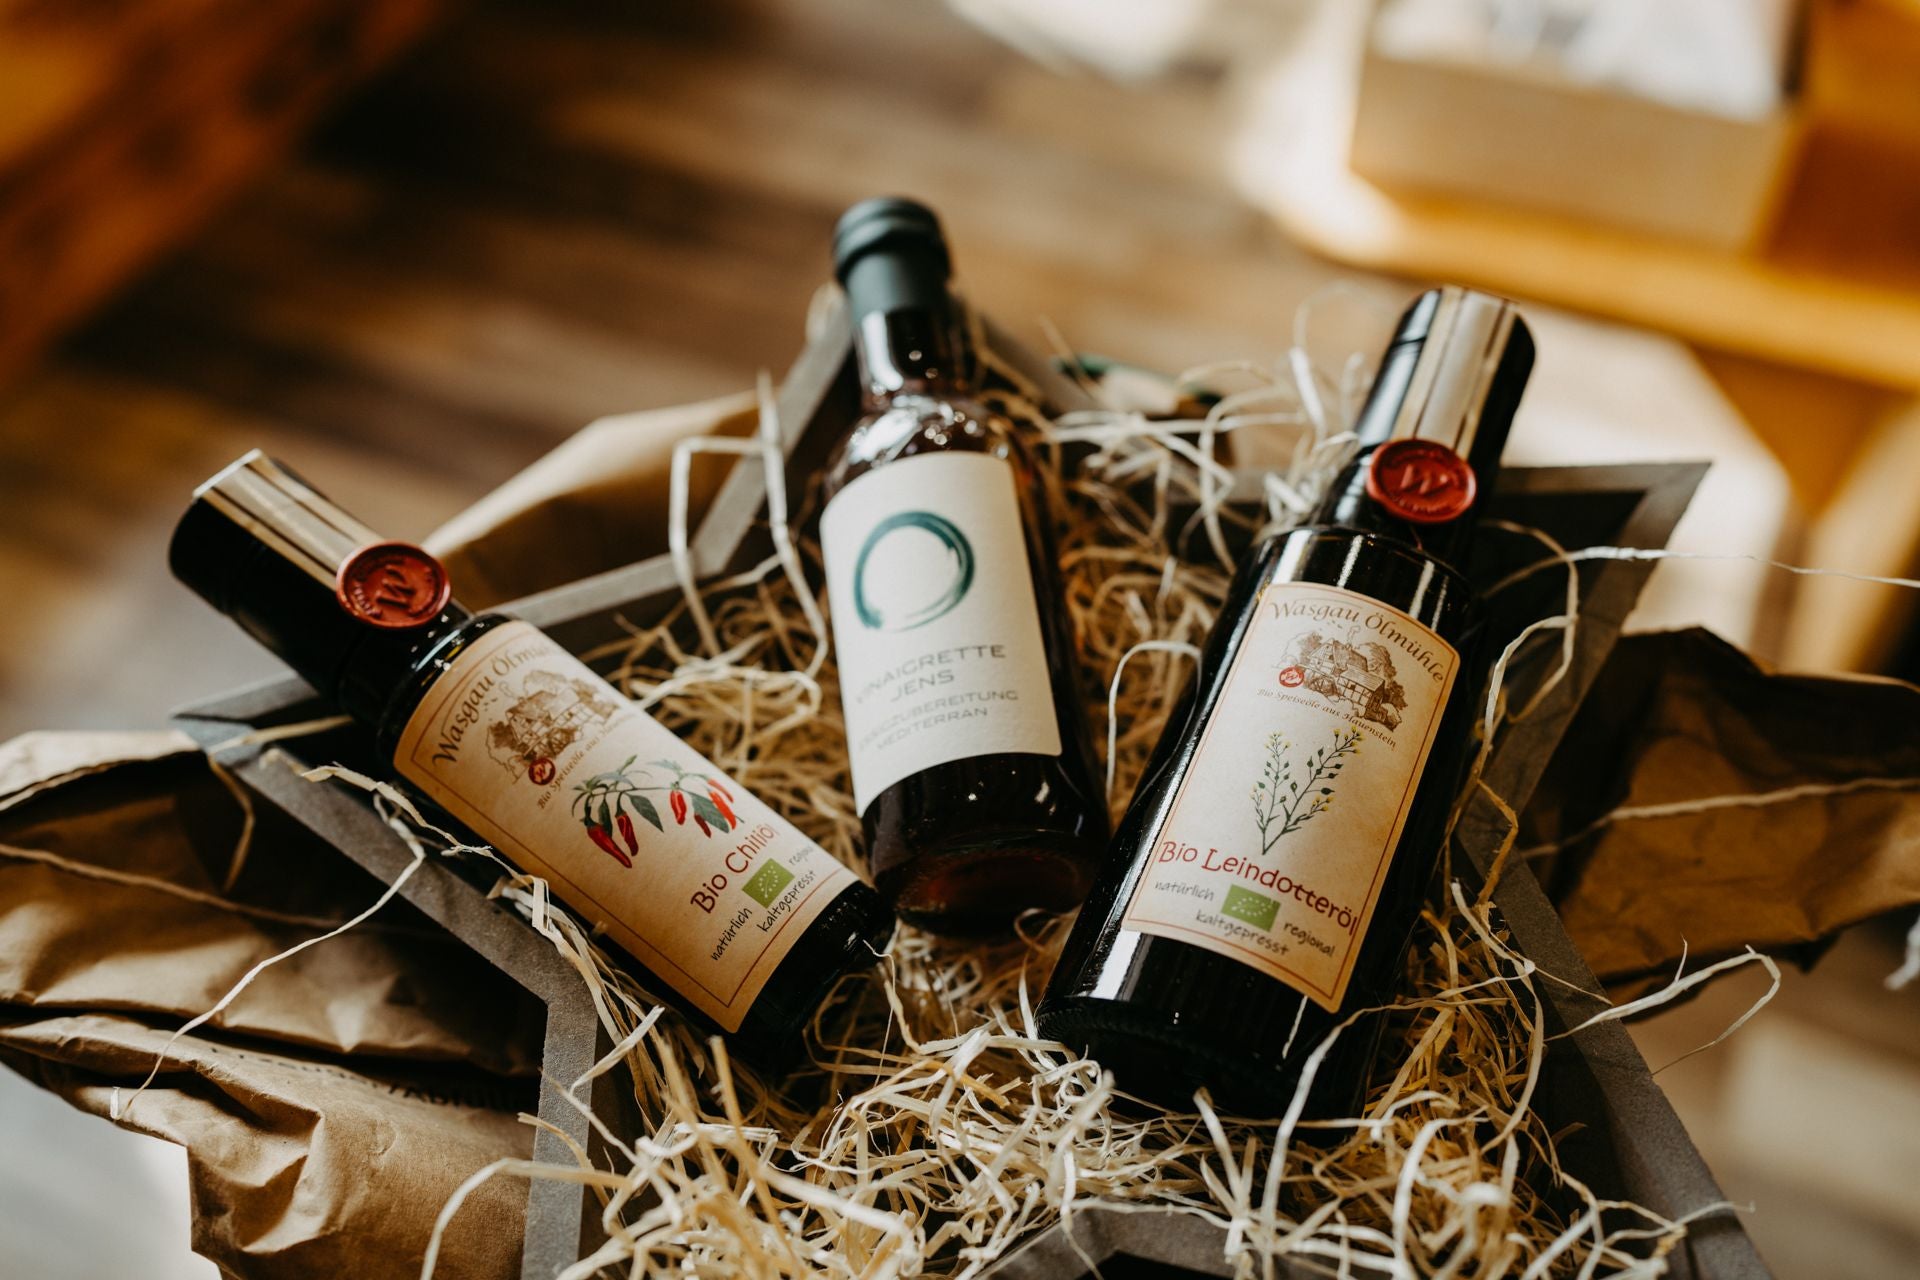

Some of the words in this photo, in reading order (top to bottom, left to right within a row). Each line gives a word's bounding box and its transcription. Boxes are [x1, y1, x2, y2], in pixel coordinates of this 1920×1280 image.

[1269, 596, 1364, 622] Wasgau
[1365, 612, 1445, 684] Ölmühle
[890, 668, 956, 704] JENS
[430, 669, 497, 767] Wasgau
[877, 706, 989, 750] MEDITERRAN
[1322, 705, 1342, 718] aus
[1342, 712, 1398, 750] Hauenstein
[690, 872, 729, 914] Bio
[724, 822, 781, 874] Chiliöl
[1154, 880, 1215, 902] natürlich
[1158, 841, 1199, 864] Bio
[1201, 848, 1359, 937] Leindotteröl
[756, 869, 818, 933] kaltgepresst
[710, 906, 754, 962] natürlich
[1195, 908, 1291, 956] kaltgepresst
[1283, 920, 1337, 958] regional
